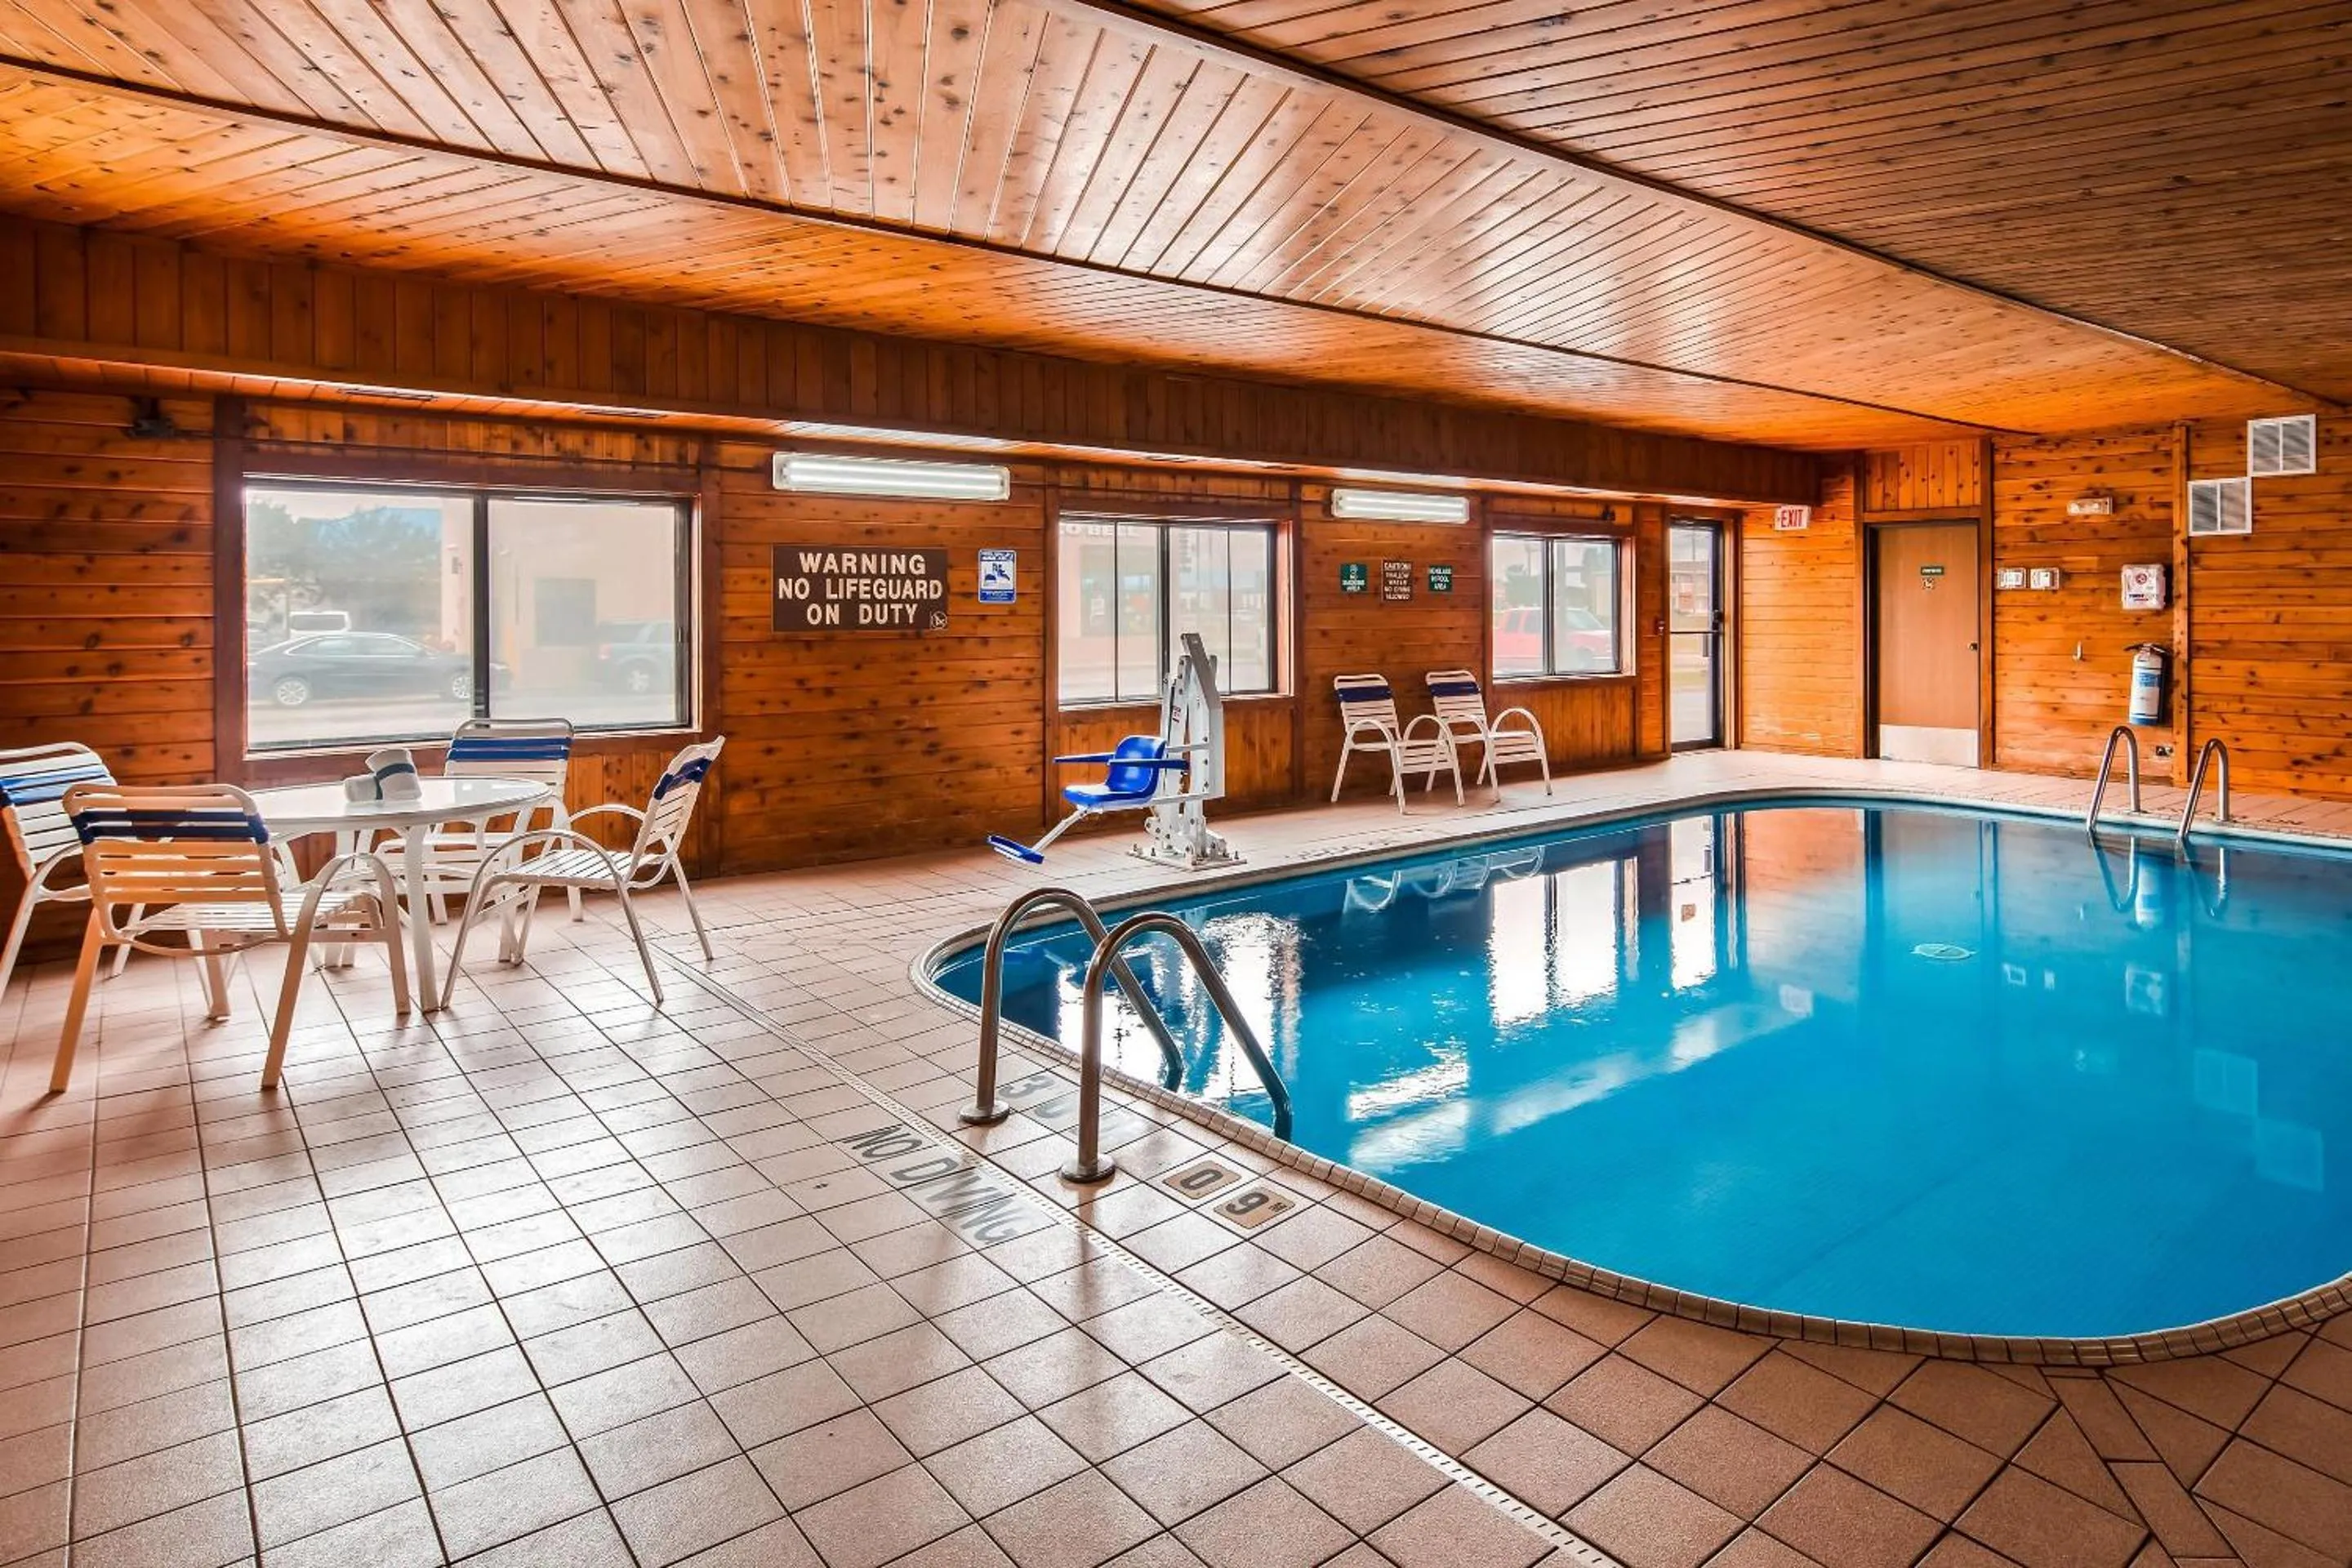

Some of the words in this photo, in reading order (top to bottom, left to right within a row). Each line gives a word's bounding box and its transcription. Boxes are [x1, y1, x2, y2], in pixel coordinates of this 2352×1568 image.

[1781, 510, 1803, 528] EXIT
[799, 552, 926, 575] WARNING
[778, 577, 810, 599] NO
[826, 578, 943, 599] LIFEGUARD
[807, 603, 840, 625] ON
[858, 604, 918, 625] DUTY
[843, 1124, 923, 1158] NO
[889, 1157, 1027, 1245] DIVING
